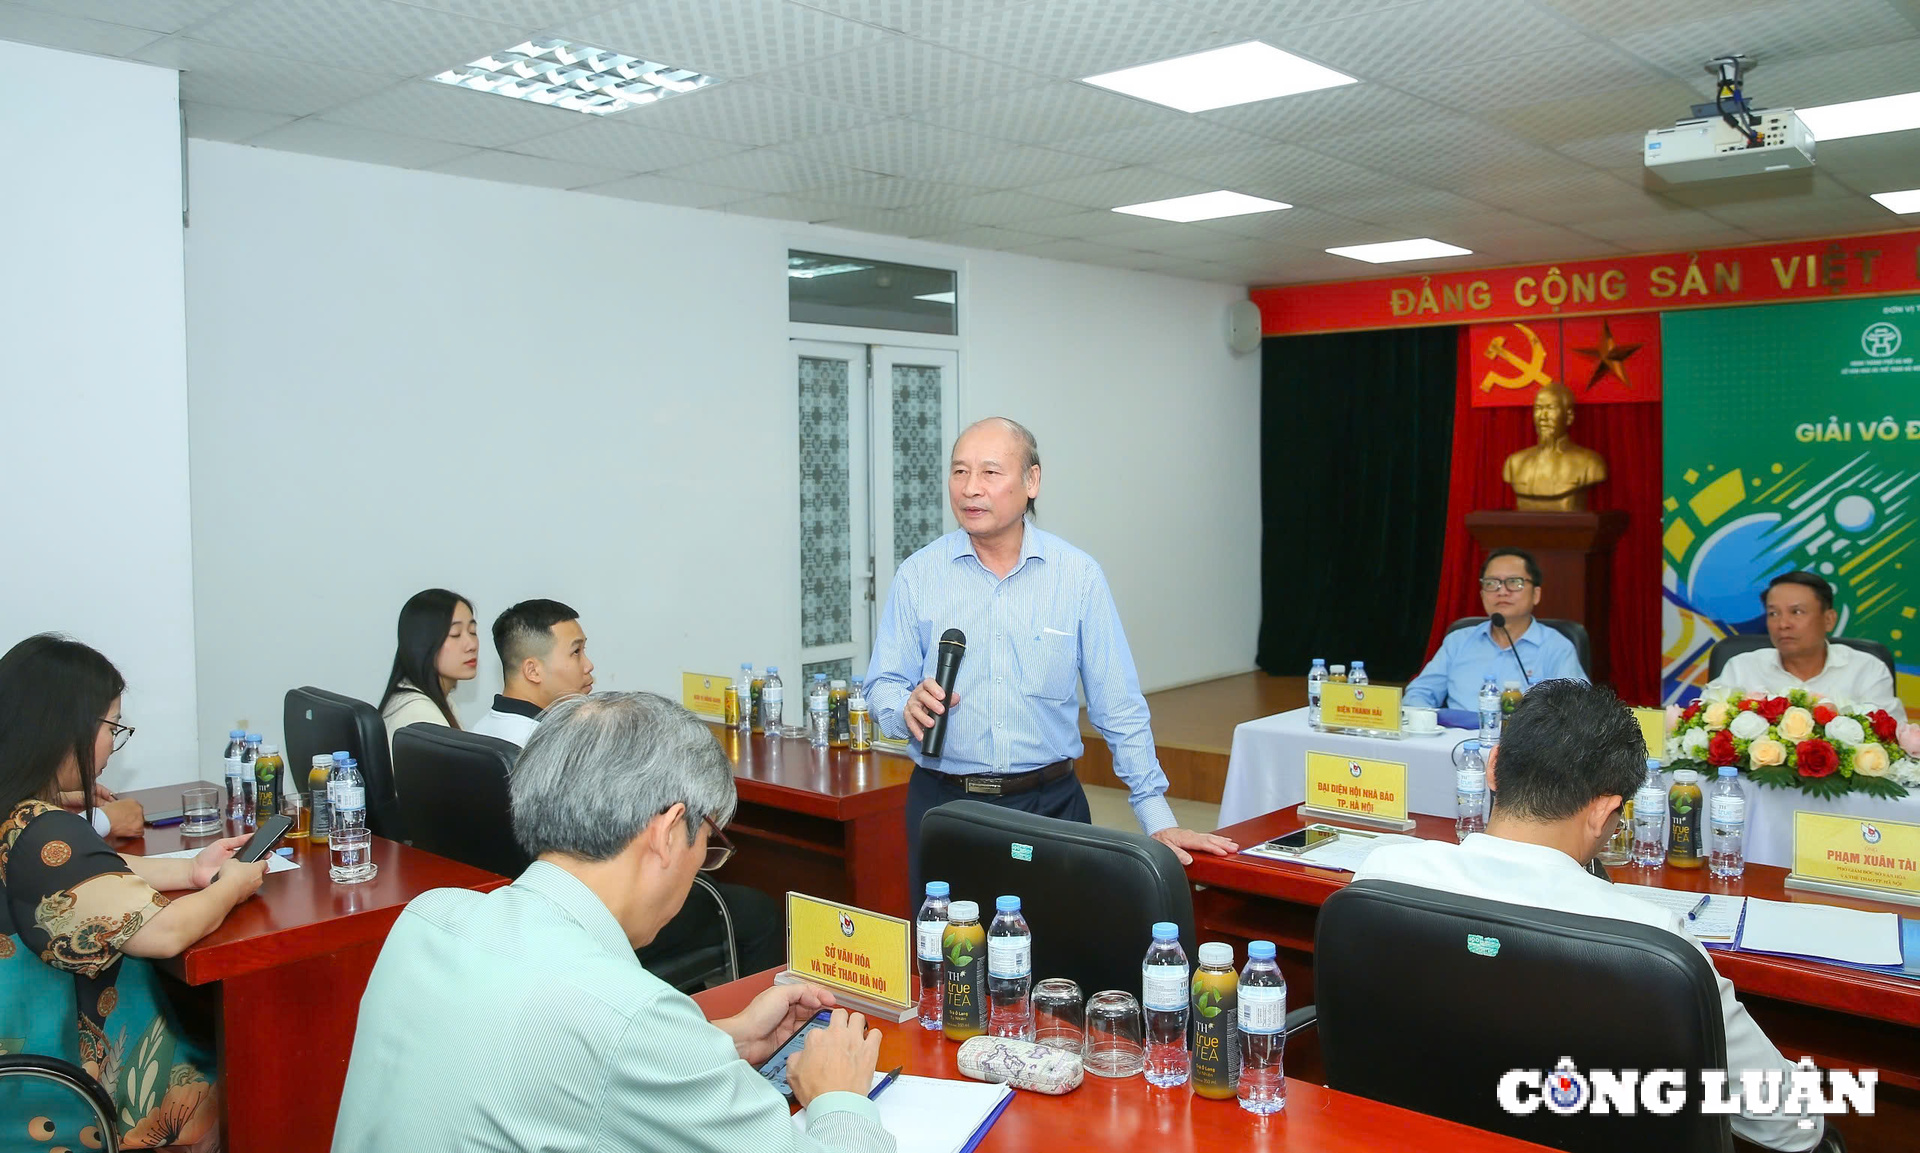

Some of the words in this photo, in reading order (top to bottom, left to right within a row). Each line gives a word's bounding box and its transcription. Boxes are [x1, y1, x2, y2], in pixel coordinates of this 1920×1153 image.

[1390, 276, 1492, 316] ĐẢNG
[1514, 267, 1627, 312] CỘNG
[1650, 252, 1742, 298] SẢN
[1771, 243, 1882, 294] VIỆT
[1795, 415, 1851, 442] GIẢI
[1857, 415, 1900, 441] VÔ
[1317, 782, 1330, 793] ĐẠI
[1331, 784, 1348, 796] DIỆN
[1349, 785, 1361, 798] HỘI
[1362, 788, 1378, 799] NHÀ
[1380, 790, 1394, 802] BÁO
[1337, 799, 1348, 808] TP.
[1350, 800, 1360, 810] HÀ
[1361, 801, 1374, 814] NỘI
[1827, 850, 1860, 864] PHẠM
[1863, 854, 1895, 869] XUÂN
[1898, 857, 1917, 871] TÀI
[825, 943, 836, 958] SỞ
[838, 948, 852, 963] VĂN
[855, 953, 870, 968] HÓA
[811, 959, 820, 972] VÀ
[822, 962, 836, 977] THỂ
[838, 967, 857, 983] THAO
[860, 973, 870, 987] HÀ
[872, 977, 886, 993] NỘI
[948, 970, 959, 981] TH
[948, 981, 970, 994] true
[948, 992, 971, 1007] TEA
[1196, 1021, 1207, 1033] TH
[1196, 1031, 1219, 1048] true
[1196, 1043, 1218, 1061] TEA
